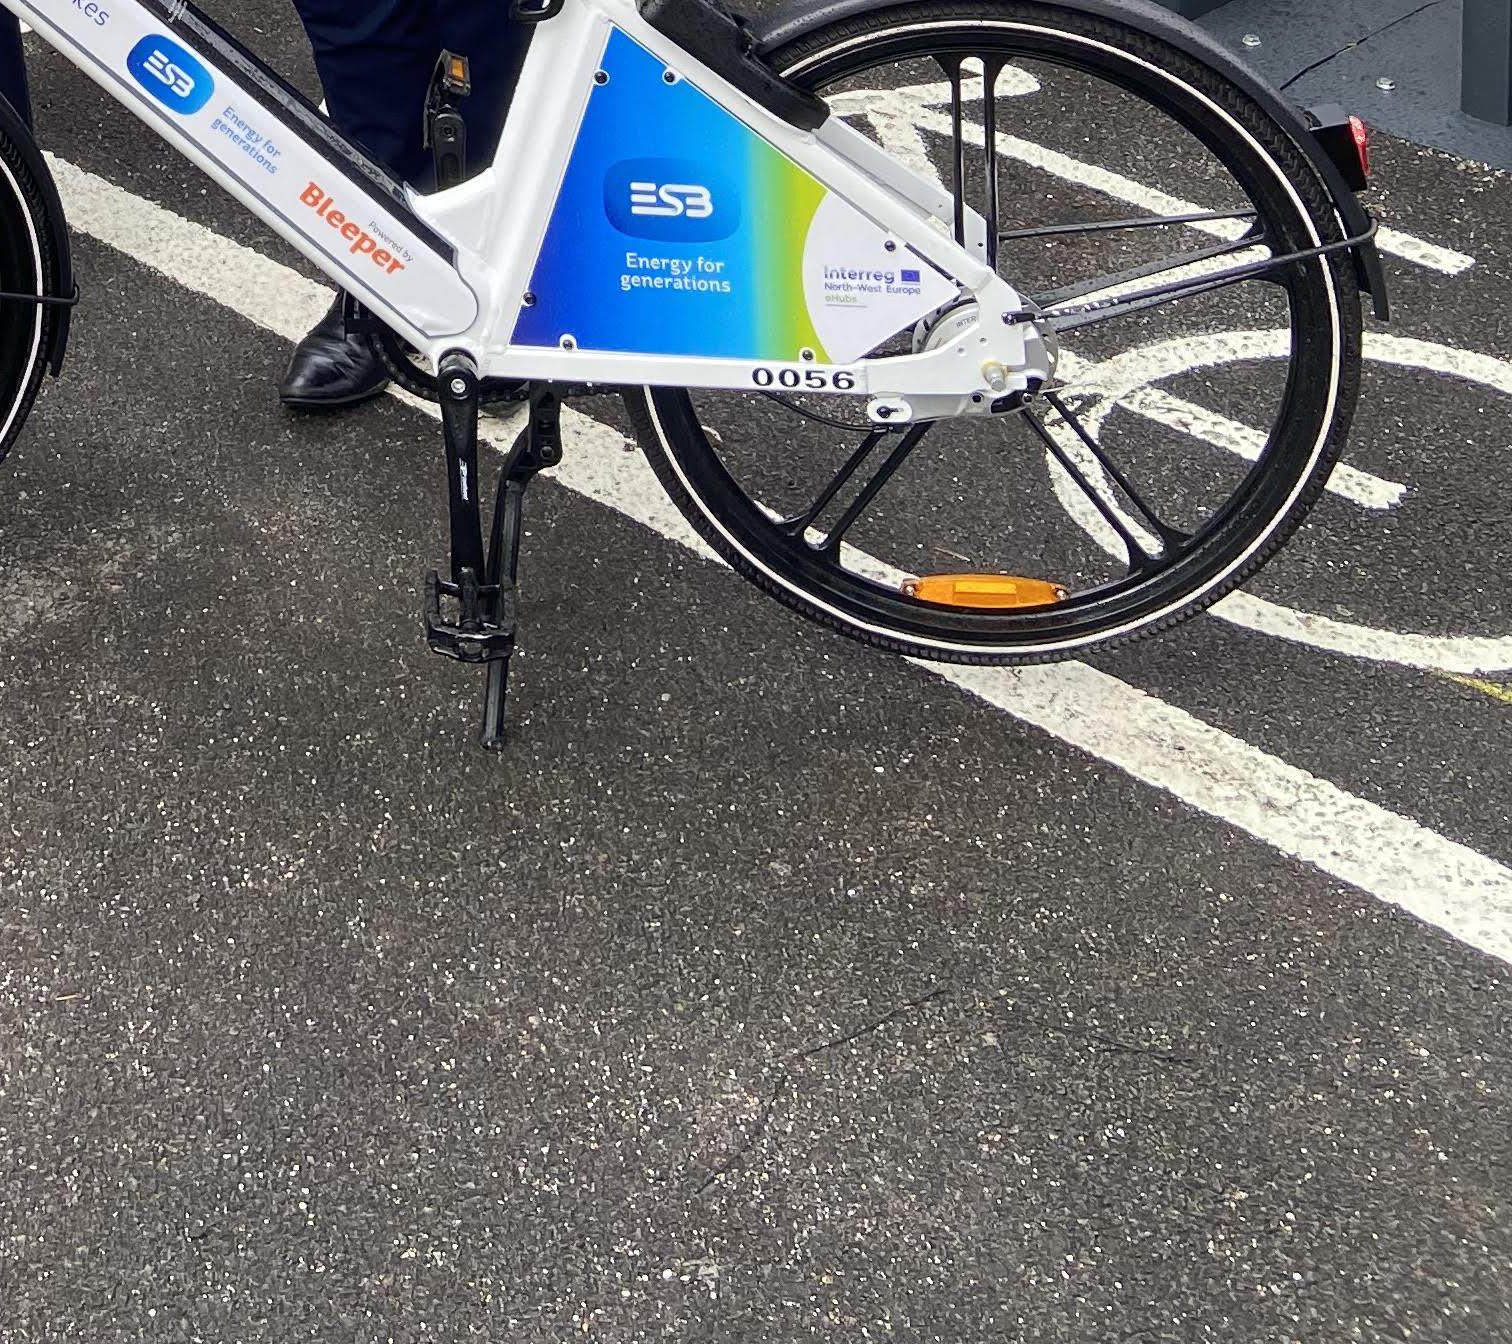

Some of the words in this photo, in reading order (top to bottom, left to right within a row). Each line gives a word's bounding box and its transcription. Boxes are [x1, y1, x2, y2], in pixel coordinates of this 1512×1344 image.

[142, 49, 196, 99] ESB
[210, 118, 279, 175] generations
[222, 106, 264, 144] Energy
[262, 139, 282, 159] for
[629, 181, 714, 219] ESB
[298, 180, 406, 275] Bleeper
[367, 219, 404, 254] Powered
[403, 247, 414, 263] by
[625, 251, 693, 276] Energy
[696, 256, 725, 273] for
[823, 265, 895, 285] Interreg
[620, 273, 731, 293] generations
[824, 282, 883, 293] North-West
[885, 284, 922, 296] Europe
[751, 367, 856, 390] 0056
